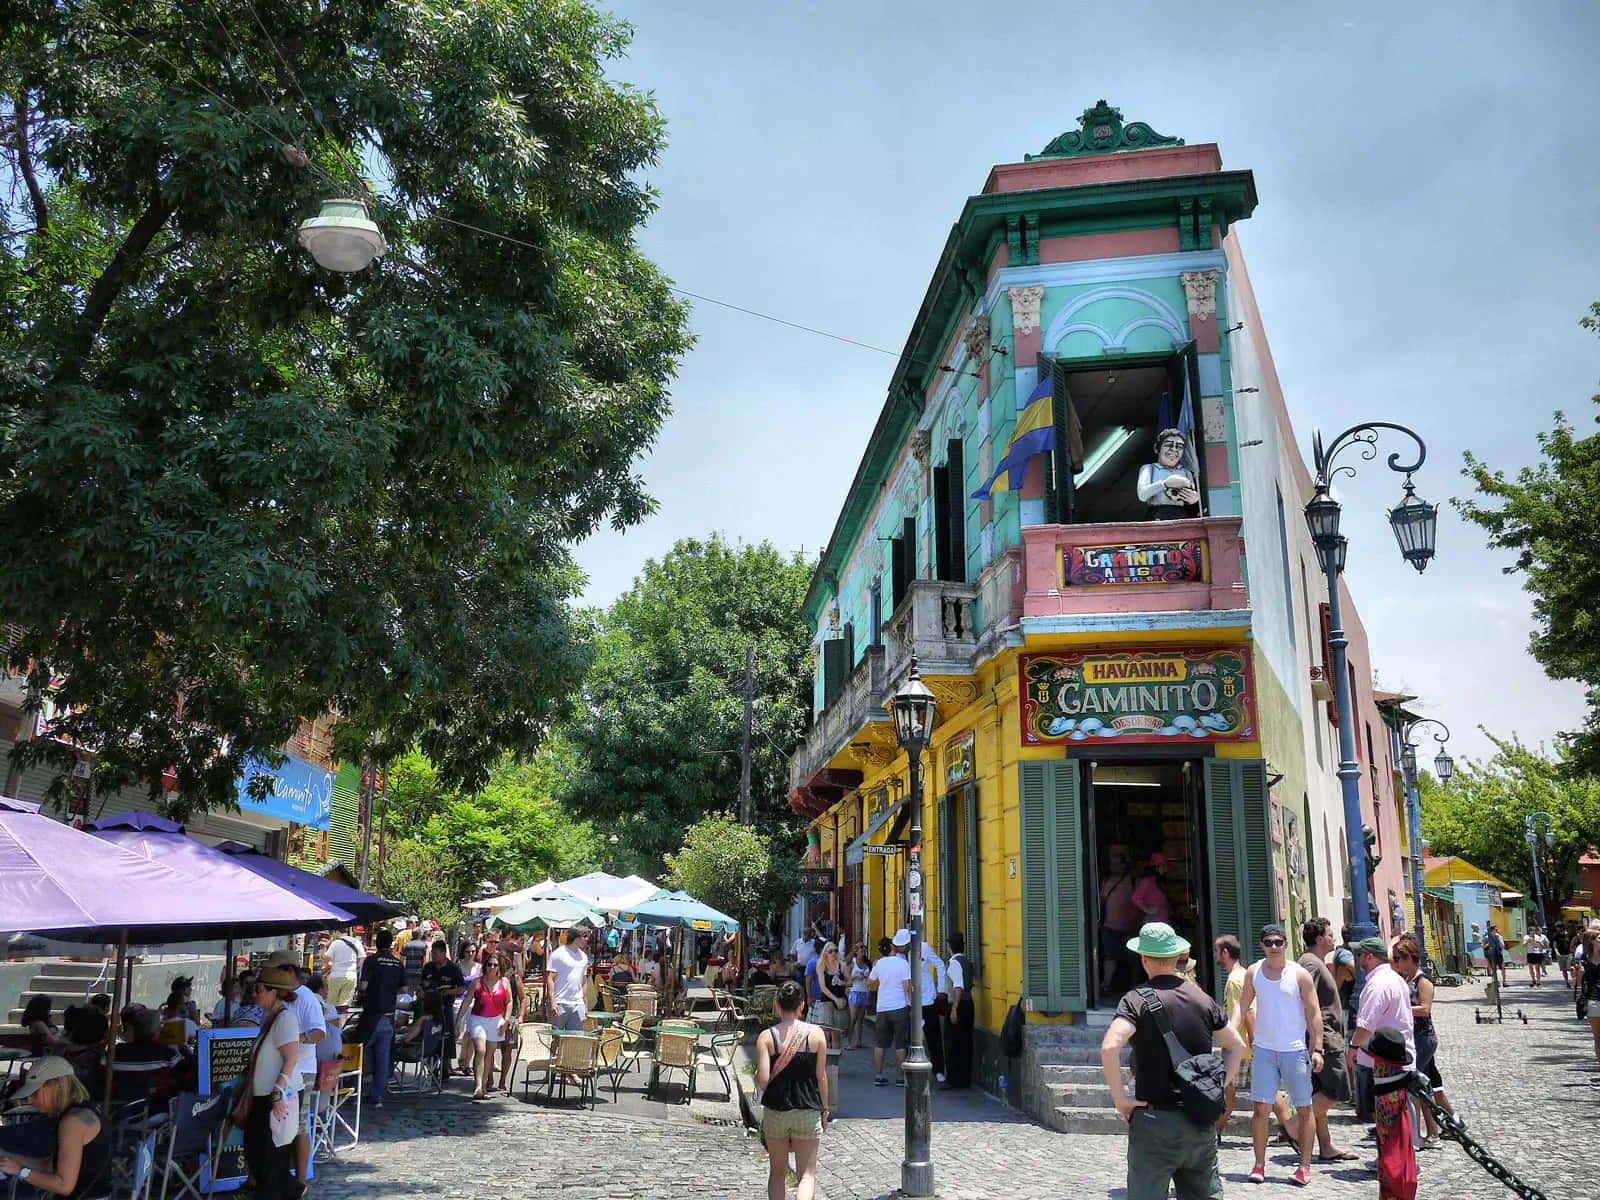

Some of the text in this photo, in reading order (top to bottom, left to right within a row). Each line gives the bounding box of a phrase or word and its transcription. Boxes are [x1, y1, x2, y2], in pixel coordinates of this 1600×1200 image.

[1086, 550, 1182, 568] CAMINITO
[1104, 567, 1165, 578] AMIGO
[1092, 661, 1178, 680] HAVANNA
[1057, 679, 1218, 715] CAMINITO
[1114, 716, 1143, 730] DESDE
[213, 1040, 253, 1049] LICUADOS
